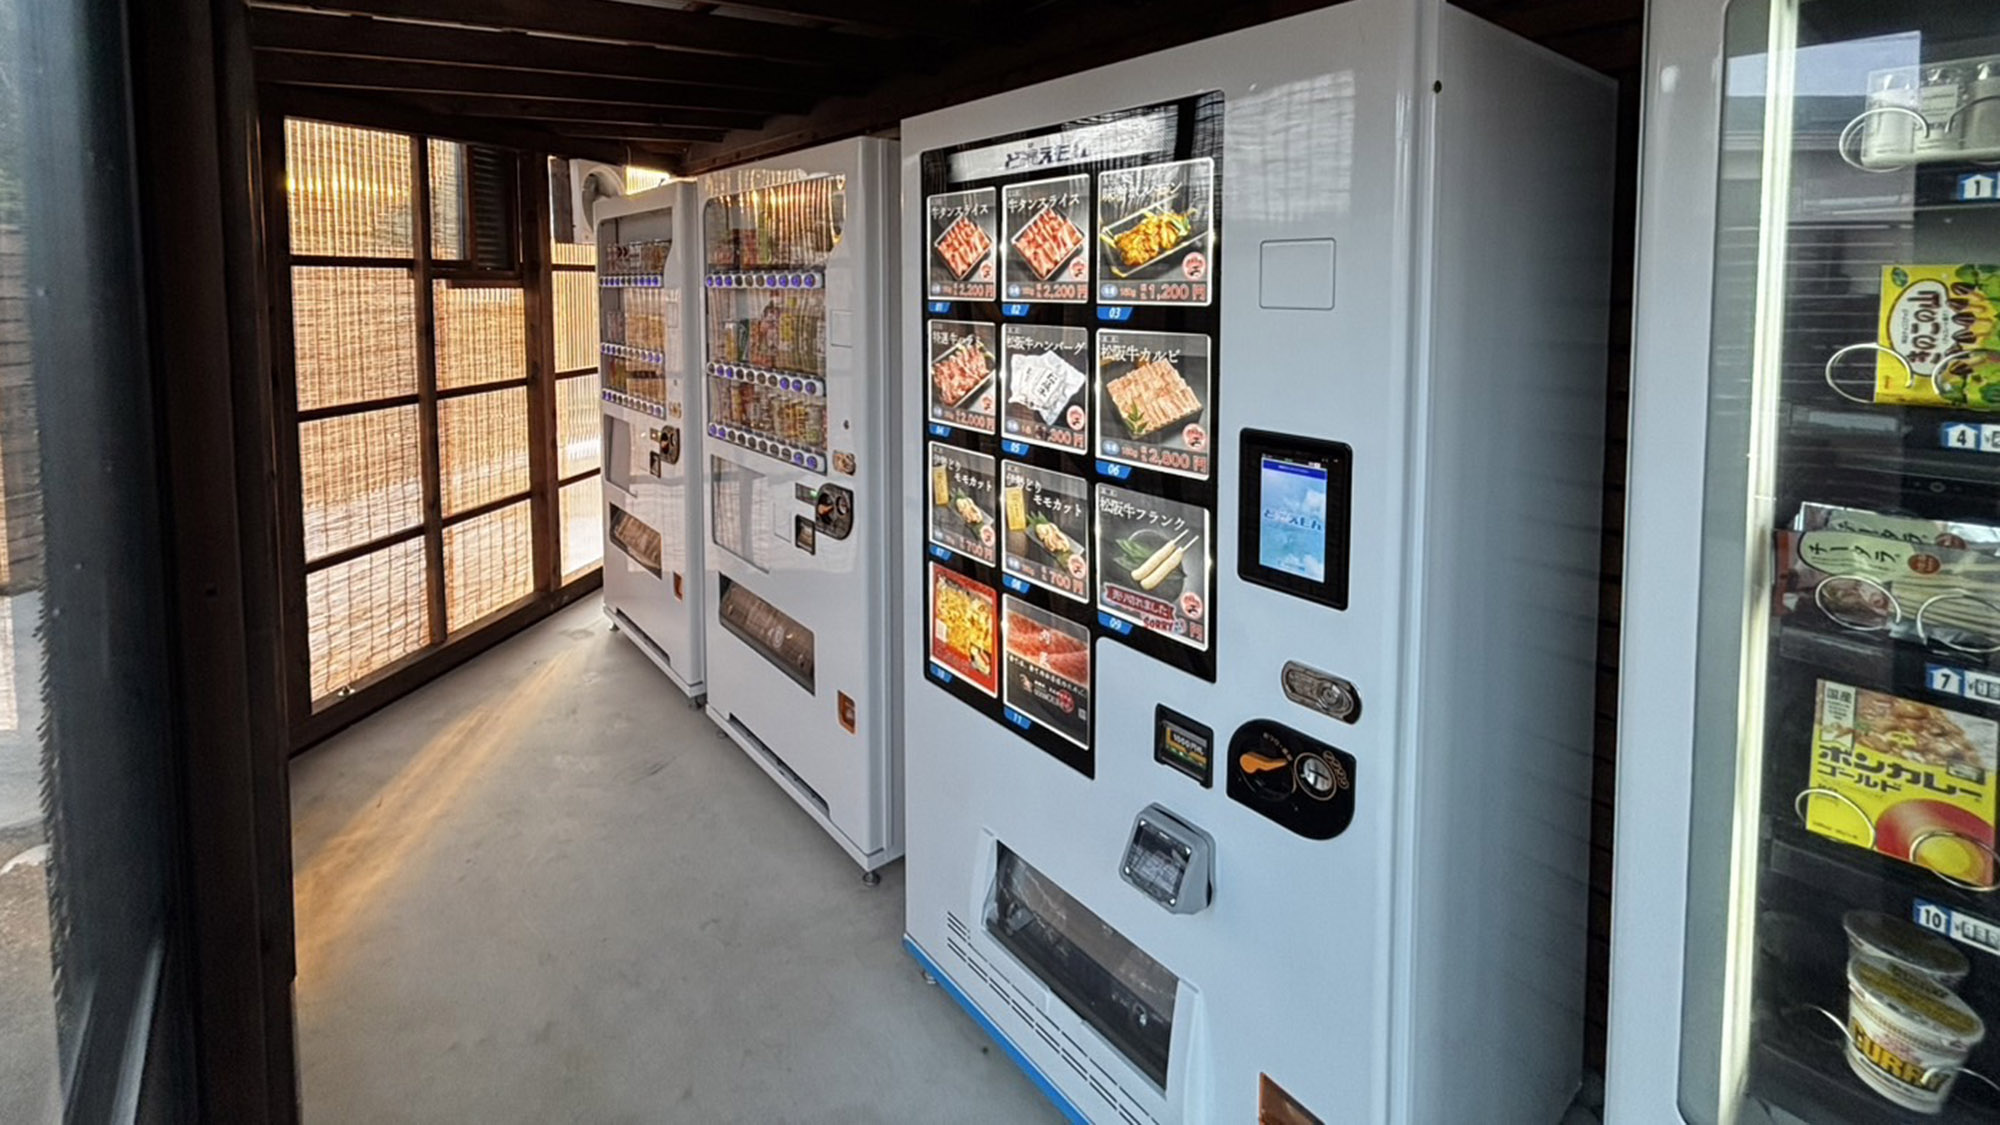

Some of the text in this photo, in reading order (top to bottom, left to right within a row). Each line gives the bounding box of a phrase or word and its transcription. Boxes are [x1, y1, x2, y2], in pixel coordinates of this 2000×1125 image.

[1974, 180, 1981, 196] 1
[1109, 307, 1121, 319] 03
[1906, 290, 1942, 365] きのこの山
[1956, 430, 1967, 446] 4
[1107, 463, 1120, 476] 06
[1941, 673, 1951, 689] 7
[1817, 761, 1902, 793] ゴールド
[1925, 908, 1942, 928] 10
